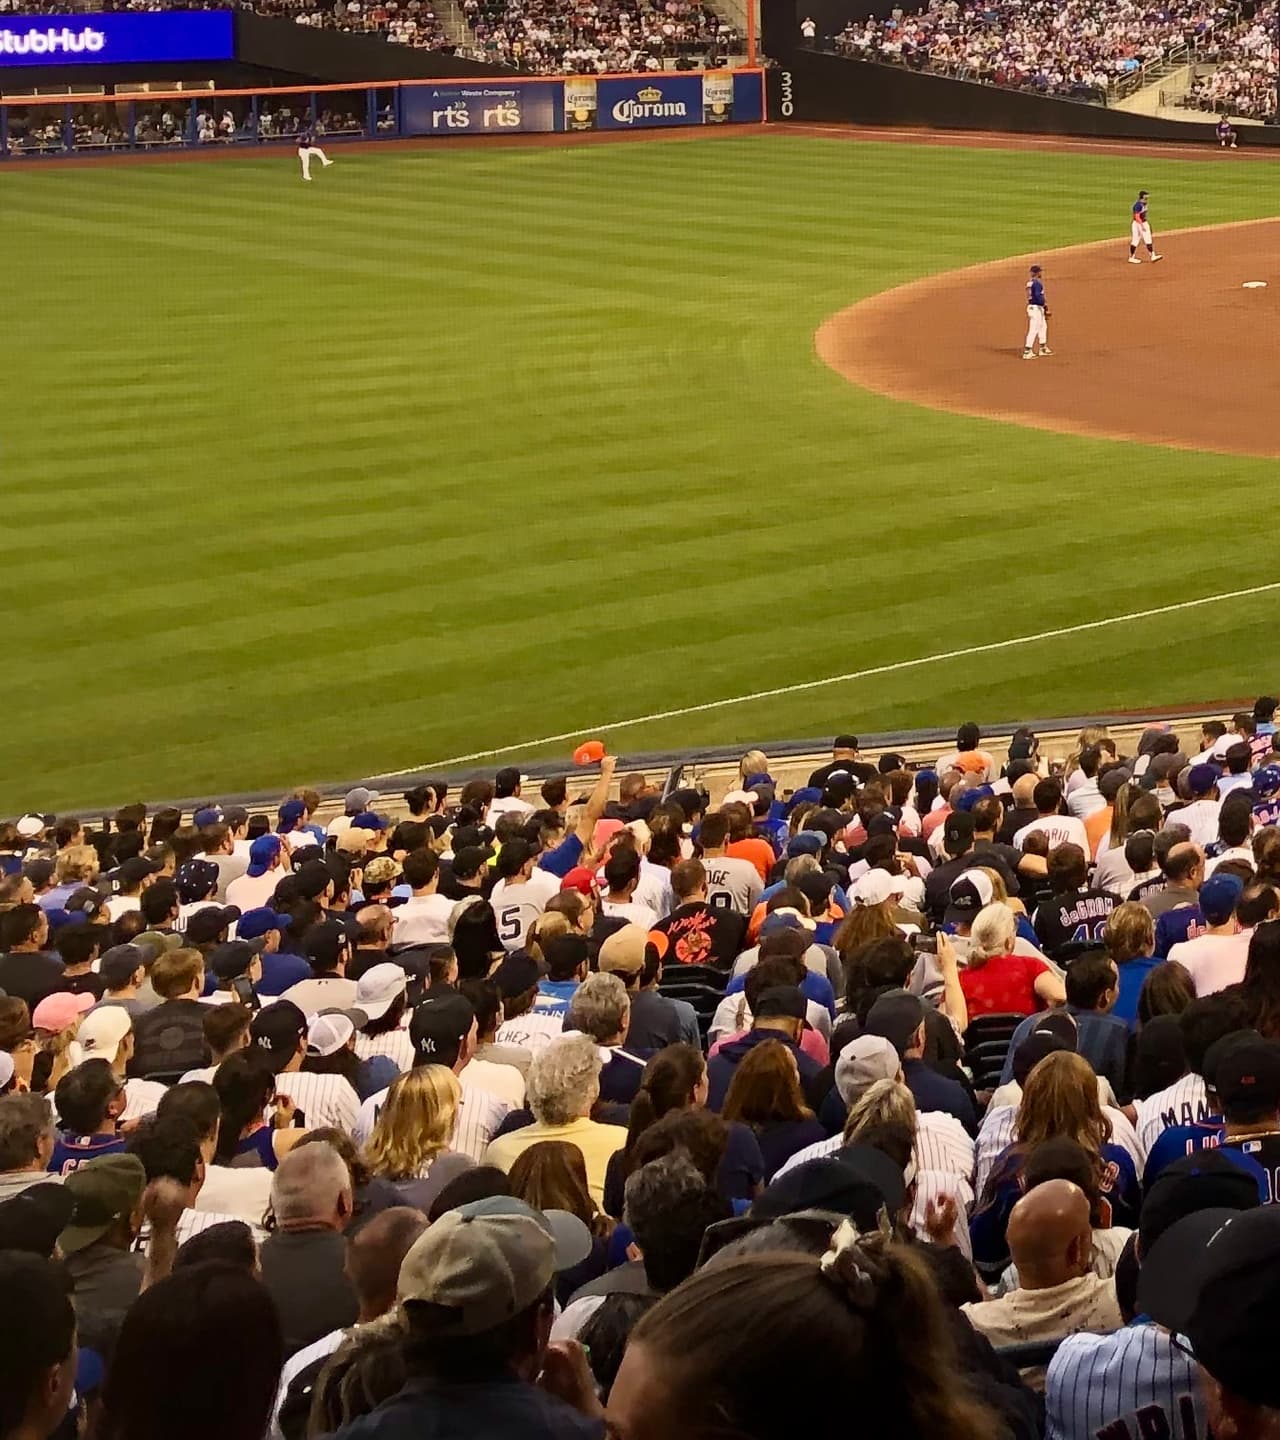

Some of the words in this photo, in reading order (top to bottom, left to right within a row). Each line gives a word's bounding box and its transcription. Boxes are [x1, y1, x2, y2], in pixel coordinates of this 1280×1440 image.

[483, 89, 516, 98] Company
[432, 104, 470, 128] rts
[483, 103, 521, 128] rts
[612, 98, 687, 124] Corona
[258, 1035, 272, 1050] NY
[421, 1037, 437, 1053] NY
